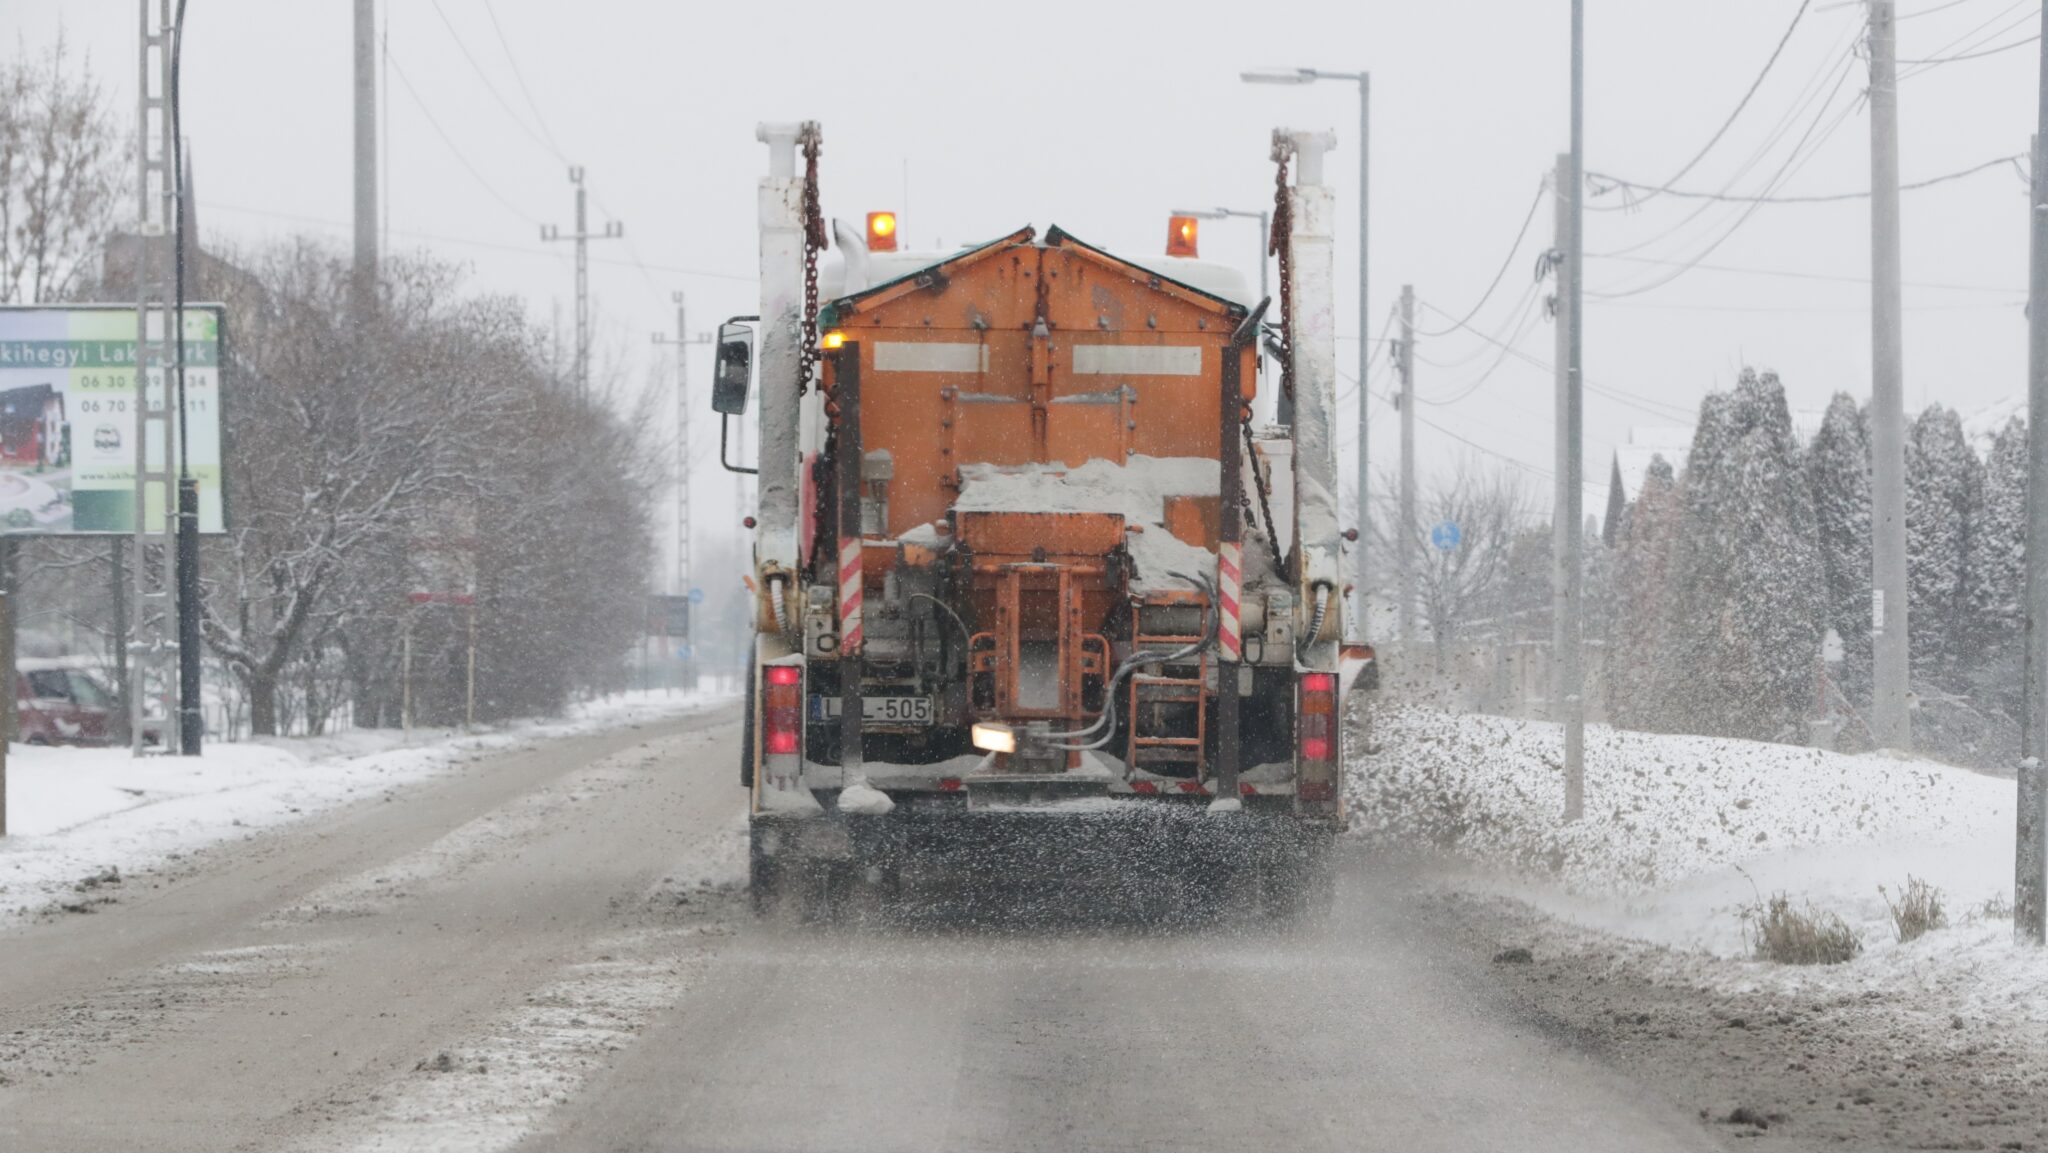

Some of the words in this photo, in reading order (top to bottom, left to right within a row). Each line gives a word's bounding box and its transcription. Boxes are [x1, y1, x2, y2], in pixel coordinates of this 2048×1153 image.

[0, 343, 88, 367] kihegyi
[100, 343, 206, 367] Lakrk
[81, 376, 99, 388] 06
[107, 376, 125, 388] 30
[82, 401, 99, 412] 06
[107, 401, 125, 412] 70
[826, 699, 927, 719] LL-505
